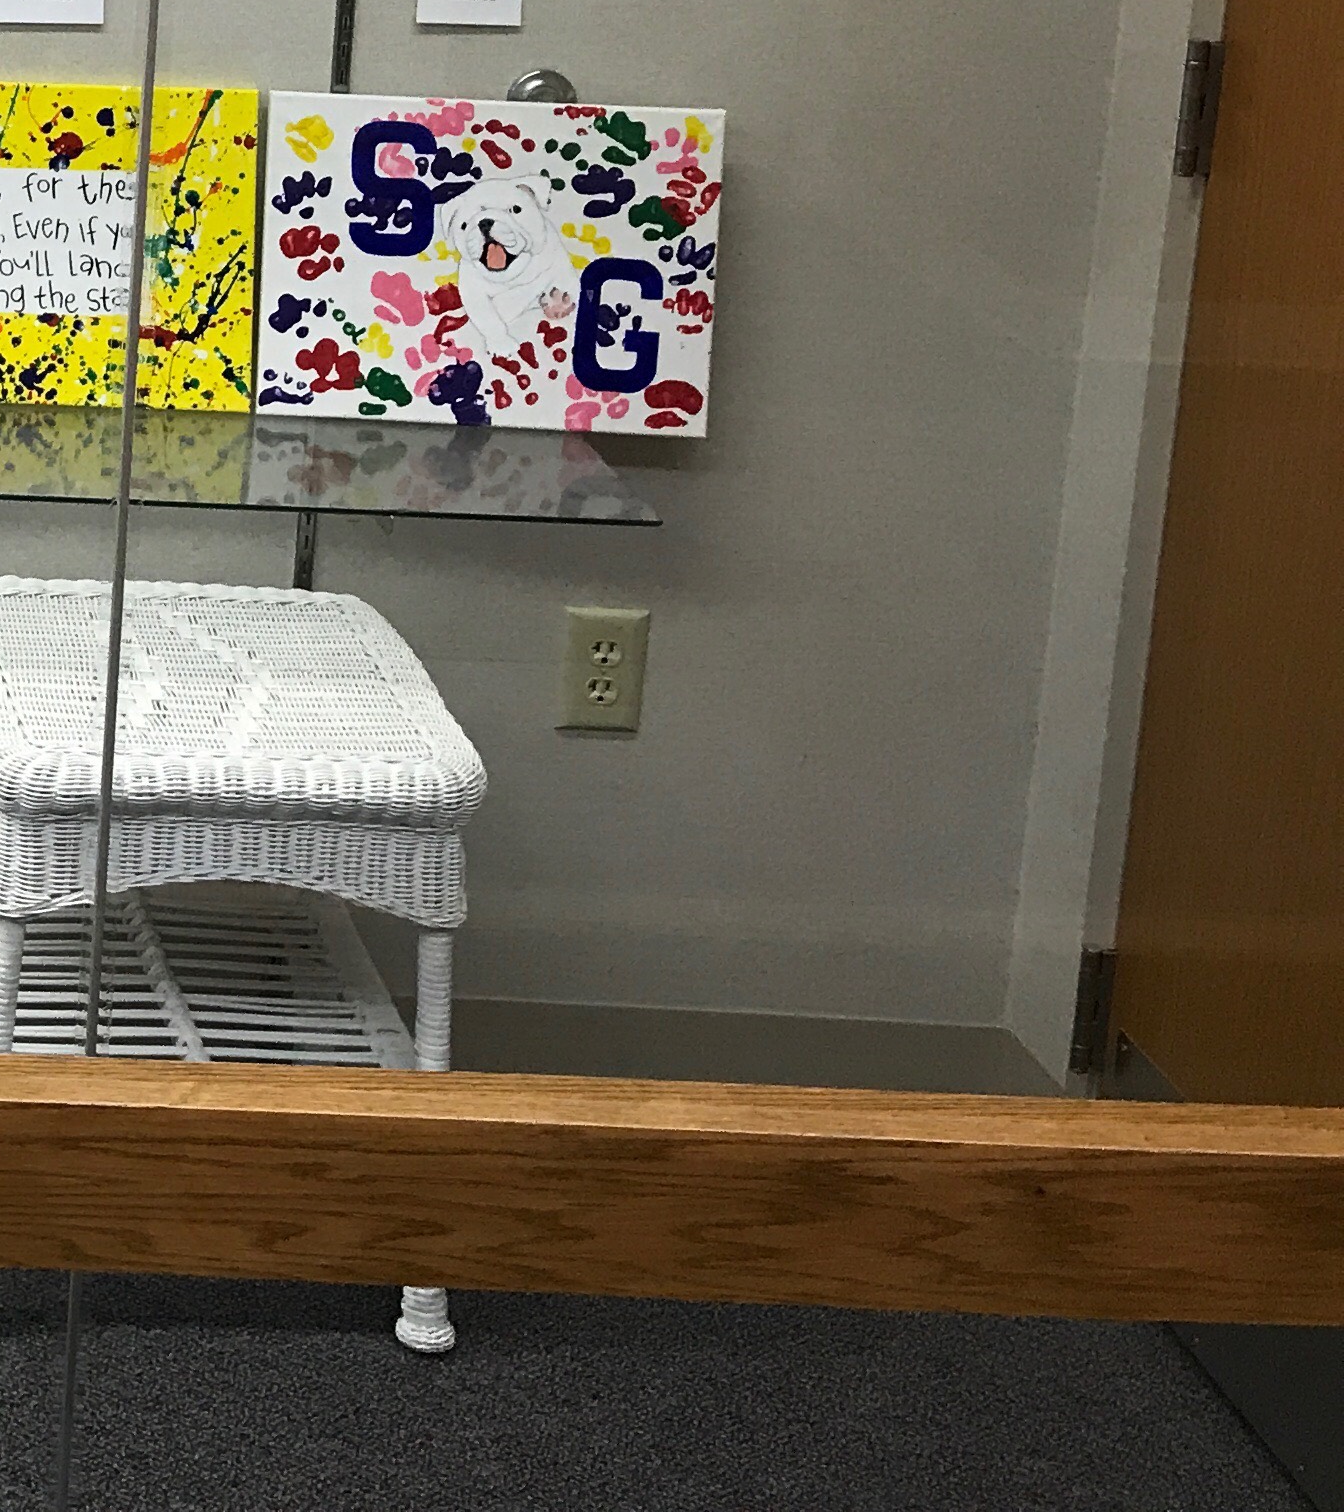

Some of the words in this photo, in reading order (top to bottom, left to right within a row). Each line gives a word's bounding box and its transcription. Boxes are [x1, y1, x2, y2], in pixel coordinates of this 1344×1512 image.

[22, 172, 63, 202] for
[77, 172, 135, 205] the
[349, 120, 437, 257] S
[12, 212, 69, 243] Even
[79, 216, 99, 245] if
[33, 279, 79, 314] the
[573, 258, 664, 394] G
